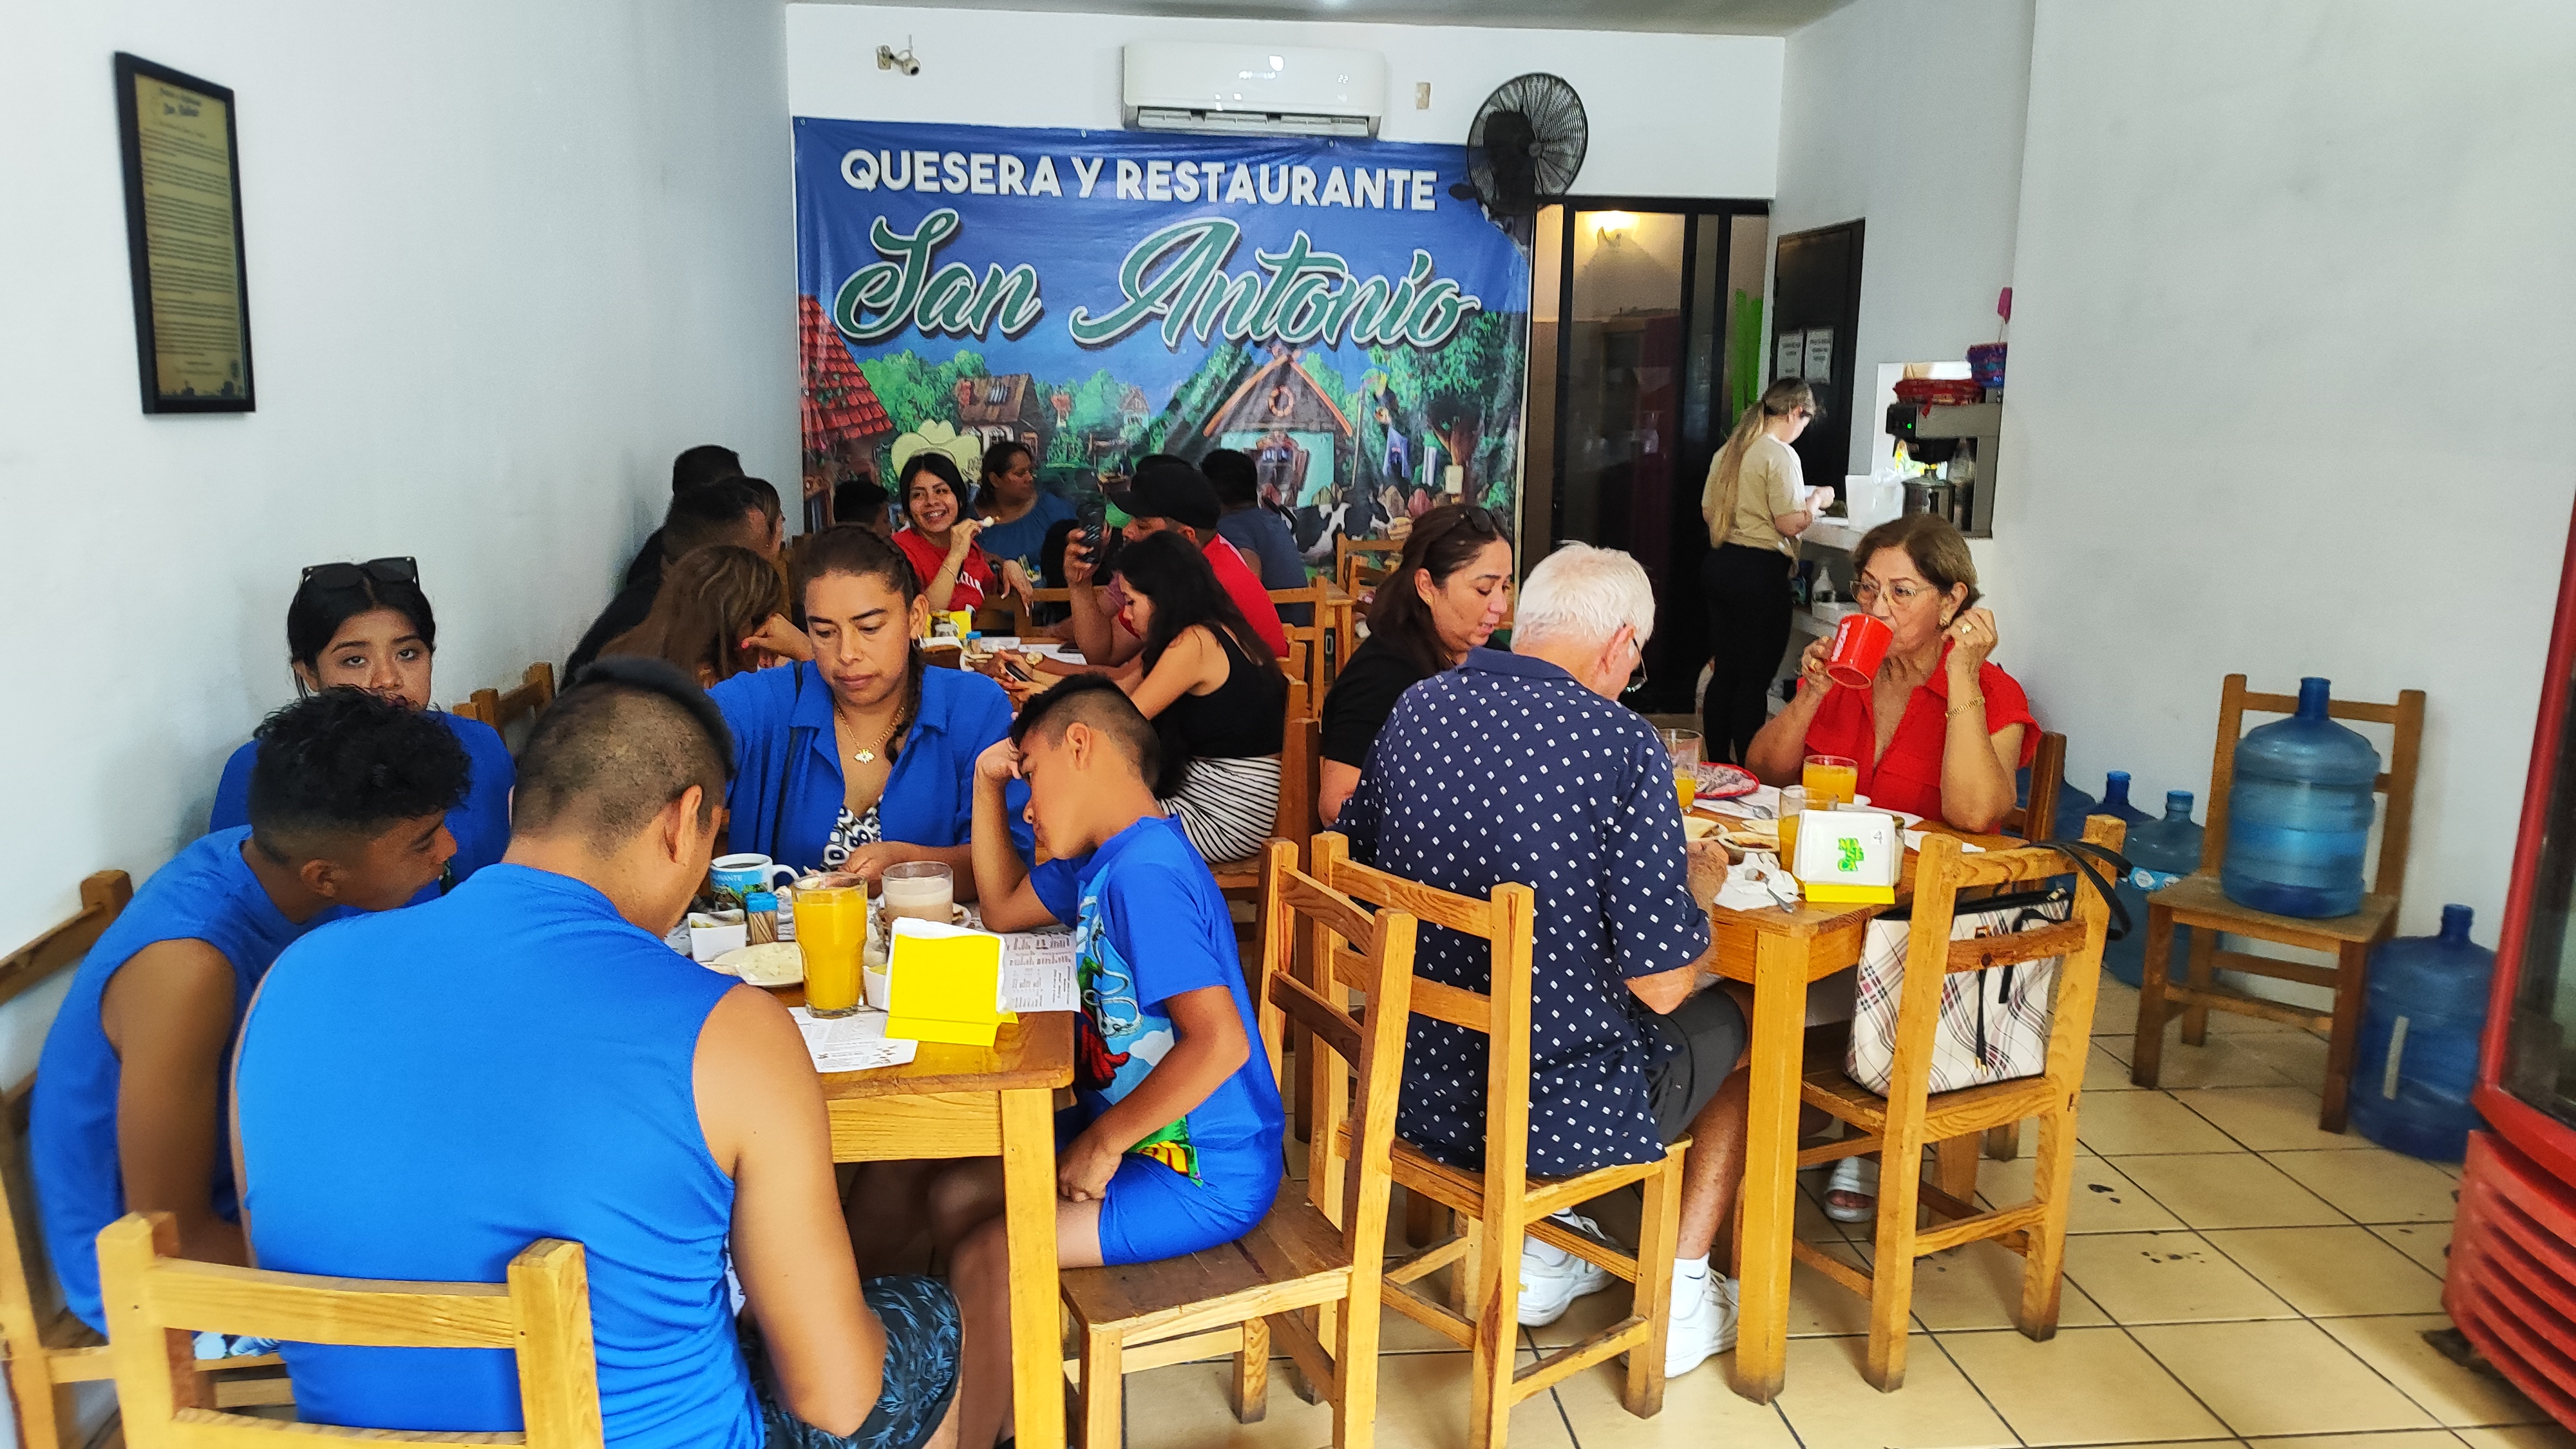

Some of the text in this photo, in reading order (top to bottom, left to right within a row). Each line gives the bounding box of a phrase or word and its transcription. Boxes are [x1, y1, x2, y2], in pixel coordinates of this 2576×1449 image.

[1338, 74, 1349, 84] 22
[840, 149, 1437, 211] QUESERA Y RESTAURANTE
[835, 207, 1481, 348] San Antonio
[1873, 830, 1883, 844] 4
